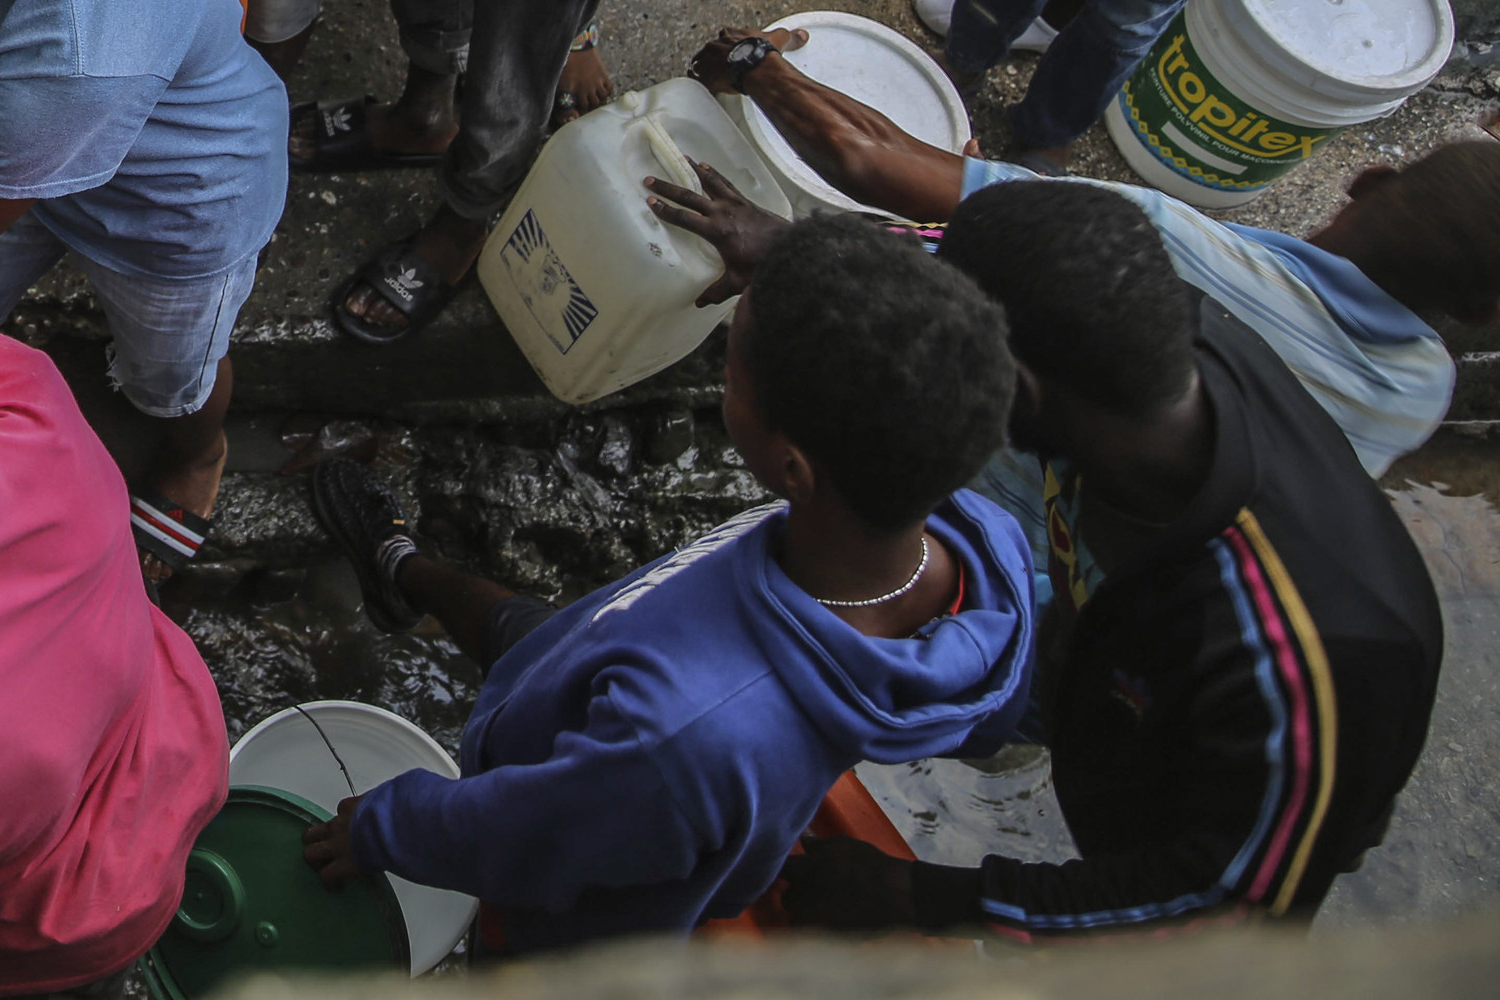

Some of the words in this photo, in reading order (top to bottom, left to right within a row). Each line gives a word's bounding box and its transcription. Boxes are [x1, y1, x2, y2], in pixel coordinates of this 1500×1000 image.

[1157, 33, 1327, 159] tropitex
[1171, 106, 1211, 143] POLYVINIL
[1212, 140, 1240, 157] POUR
